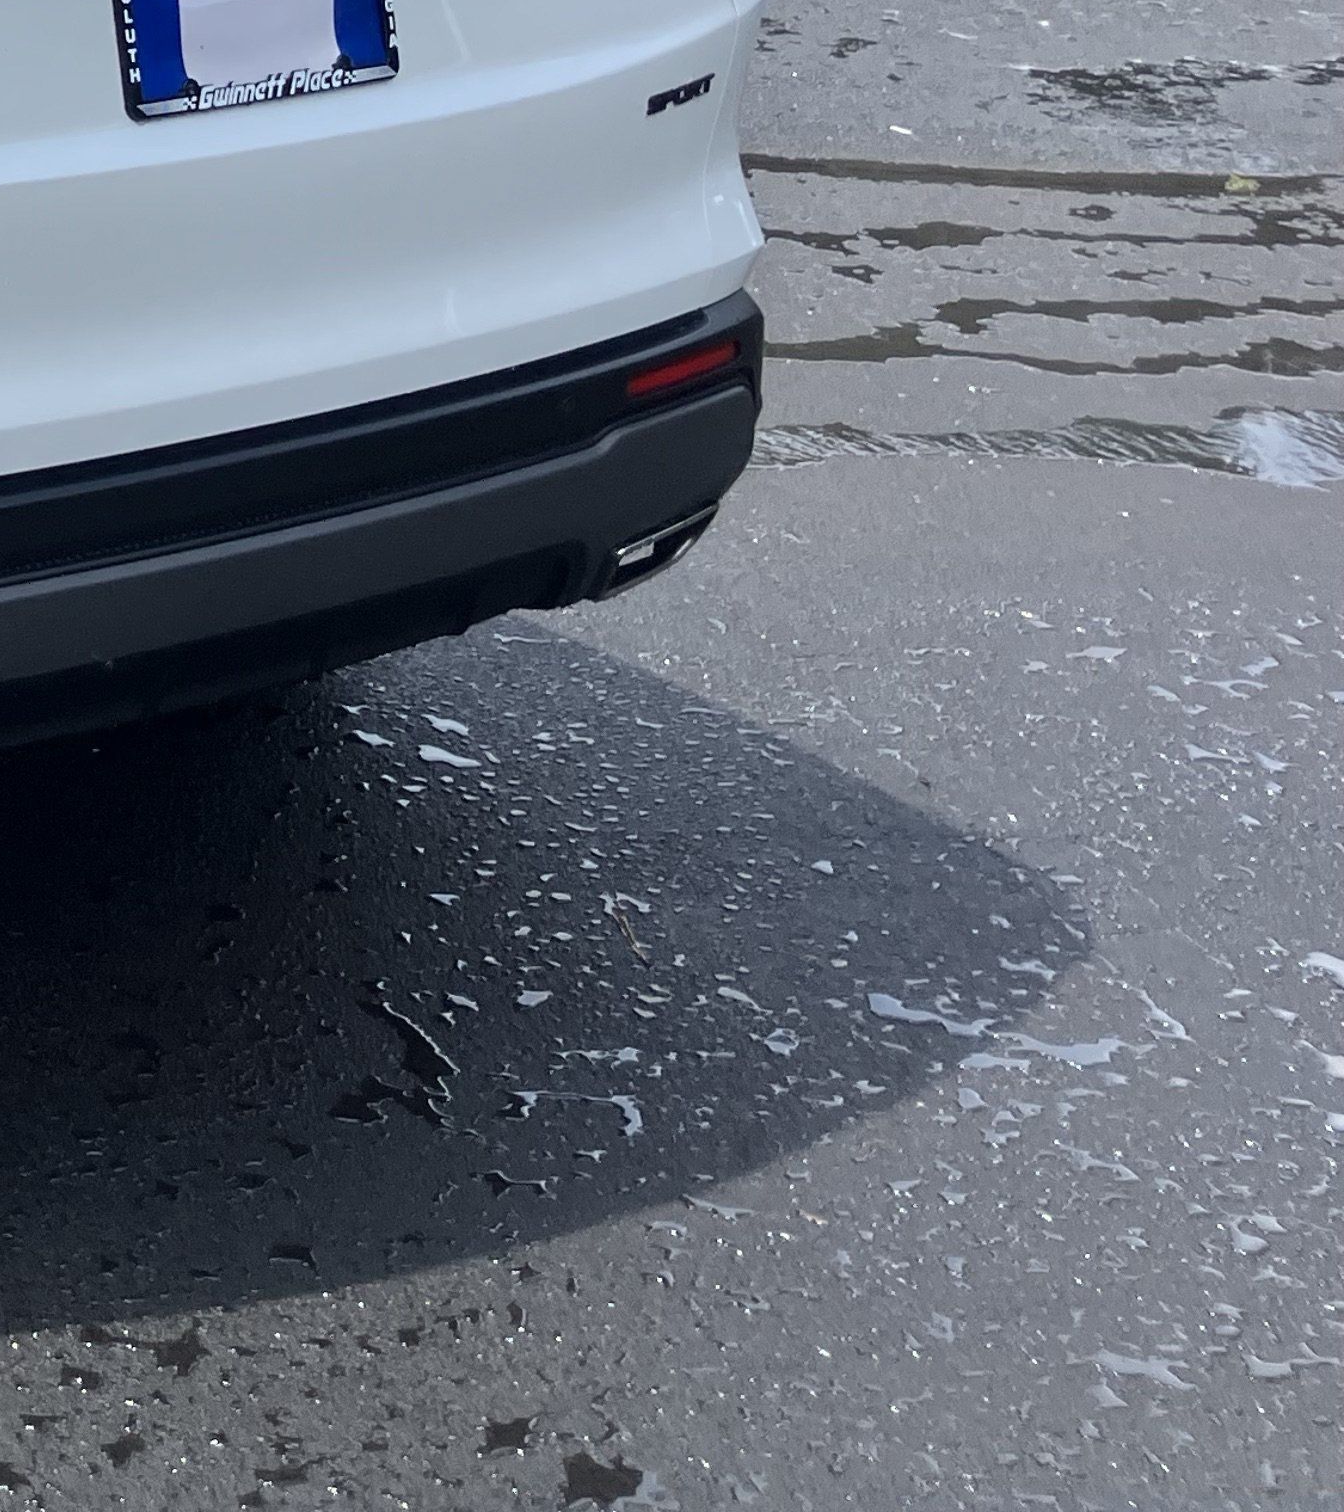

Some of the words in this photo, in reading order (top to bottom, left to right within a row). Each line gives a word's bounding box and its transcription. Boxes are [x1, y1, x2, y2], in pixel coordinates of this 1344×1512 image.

[198, 72, 287, 110] Gwinnett
[289, 68, 344, 95] Place
[646, 72, 716, 116] SPORT
